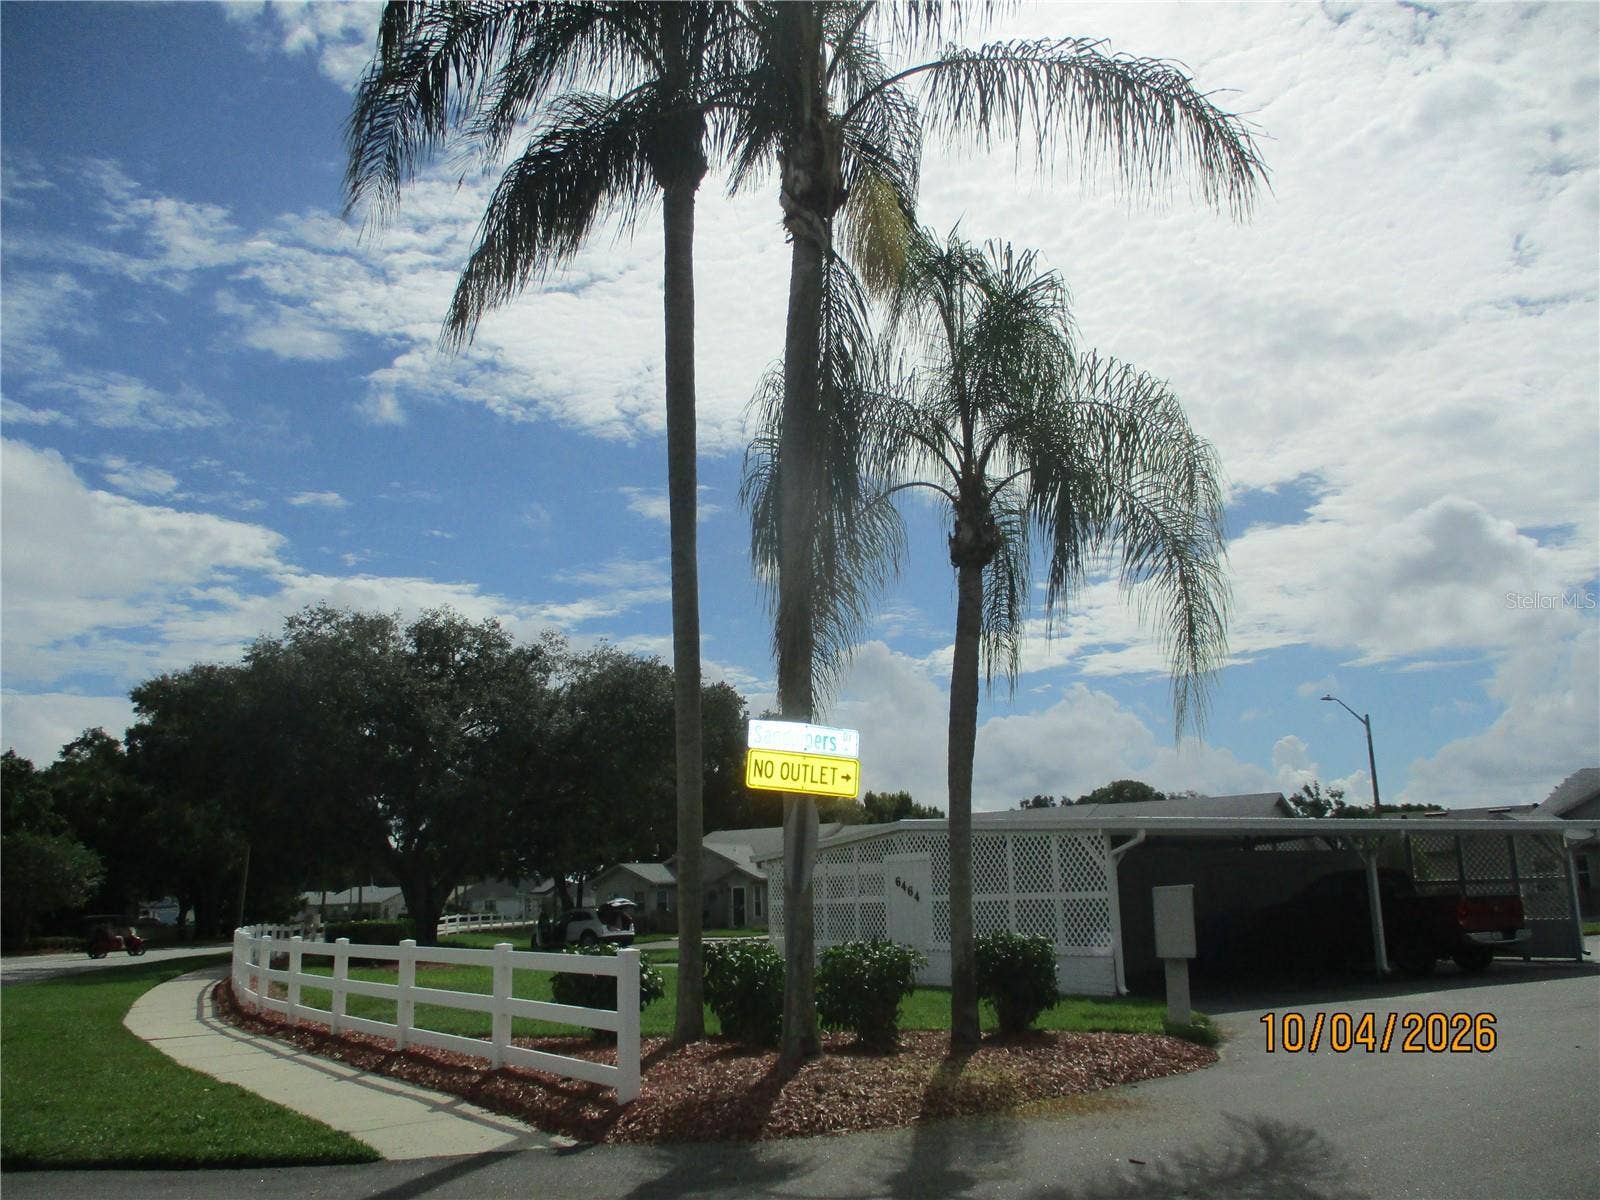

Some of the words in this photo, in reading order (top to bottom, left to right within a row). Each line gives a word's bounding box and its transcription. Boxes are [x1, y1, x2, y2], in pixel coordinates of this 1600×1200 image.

[754, 760, 773, 778] NO
[780, 763, 838, 785] OUTLET
[895, 876, 920, 901] 6464
